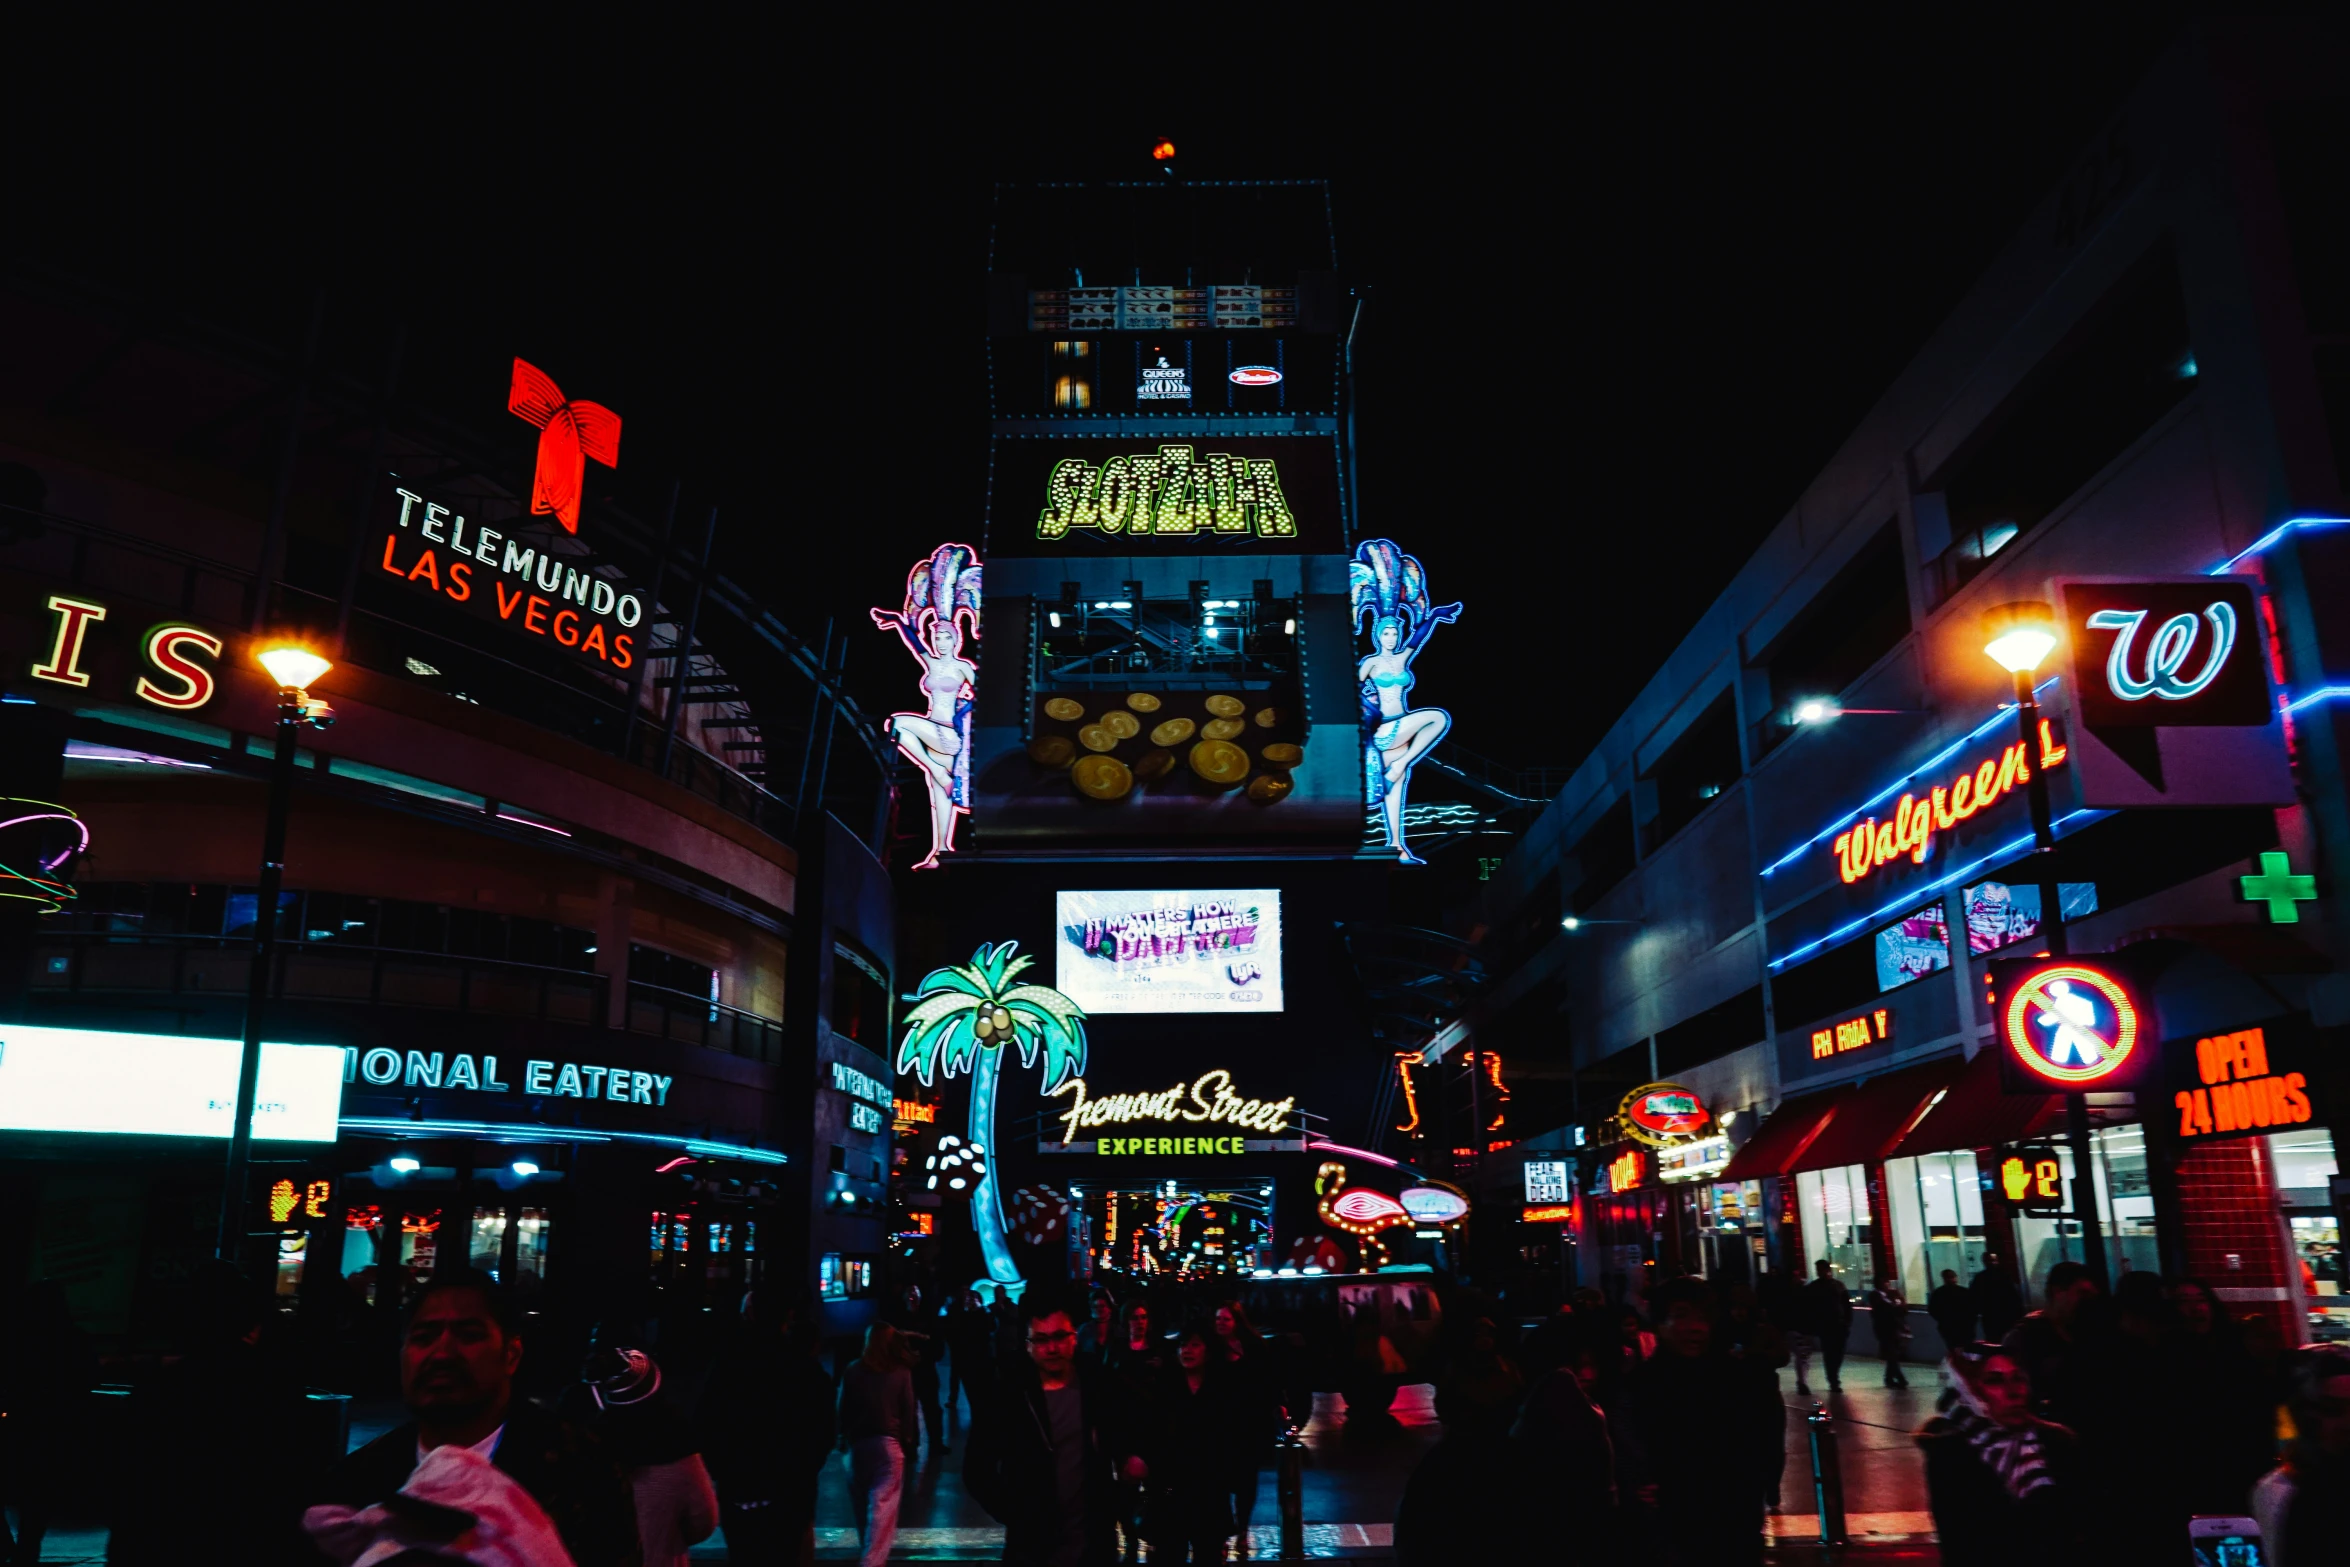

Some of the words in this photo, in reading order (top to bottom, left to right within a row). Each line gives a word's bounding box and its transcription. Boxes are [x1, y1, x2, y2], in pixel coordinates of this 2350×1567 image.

[1142, 369, 1185, 378] QUEENS
[396, 487, 642, 628] TELEMUNDO
[382, 534, 473, 602] LAS
[496, 581, 633, 669] VEGAS
[2086, 601, 2237, 701] W
[1105, 906, 1189, 930] MATTERS
[1193, 899, 1236, 917] HOW
[524, 1059, 673, 1107] EATERY
[2195, 1027, 2270, 1086] OPEN
[1051, 1078, 1185, 1147] Fremont
[1182, 1070, 1294, 1133] Street
[2174, 1088, 2212, 1137] 24
[2210, 1072, 2312, 1133] HOURS
[1097, 1136, 1245, 1155] EXPERIENCE
[1530, 1186, 1563, 1202] DEAD
[2035, 1160, 2059, 1197] 2
